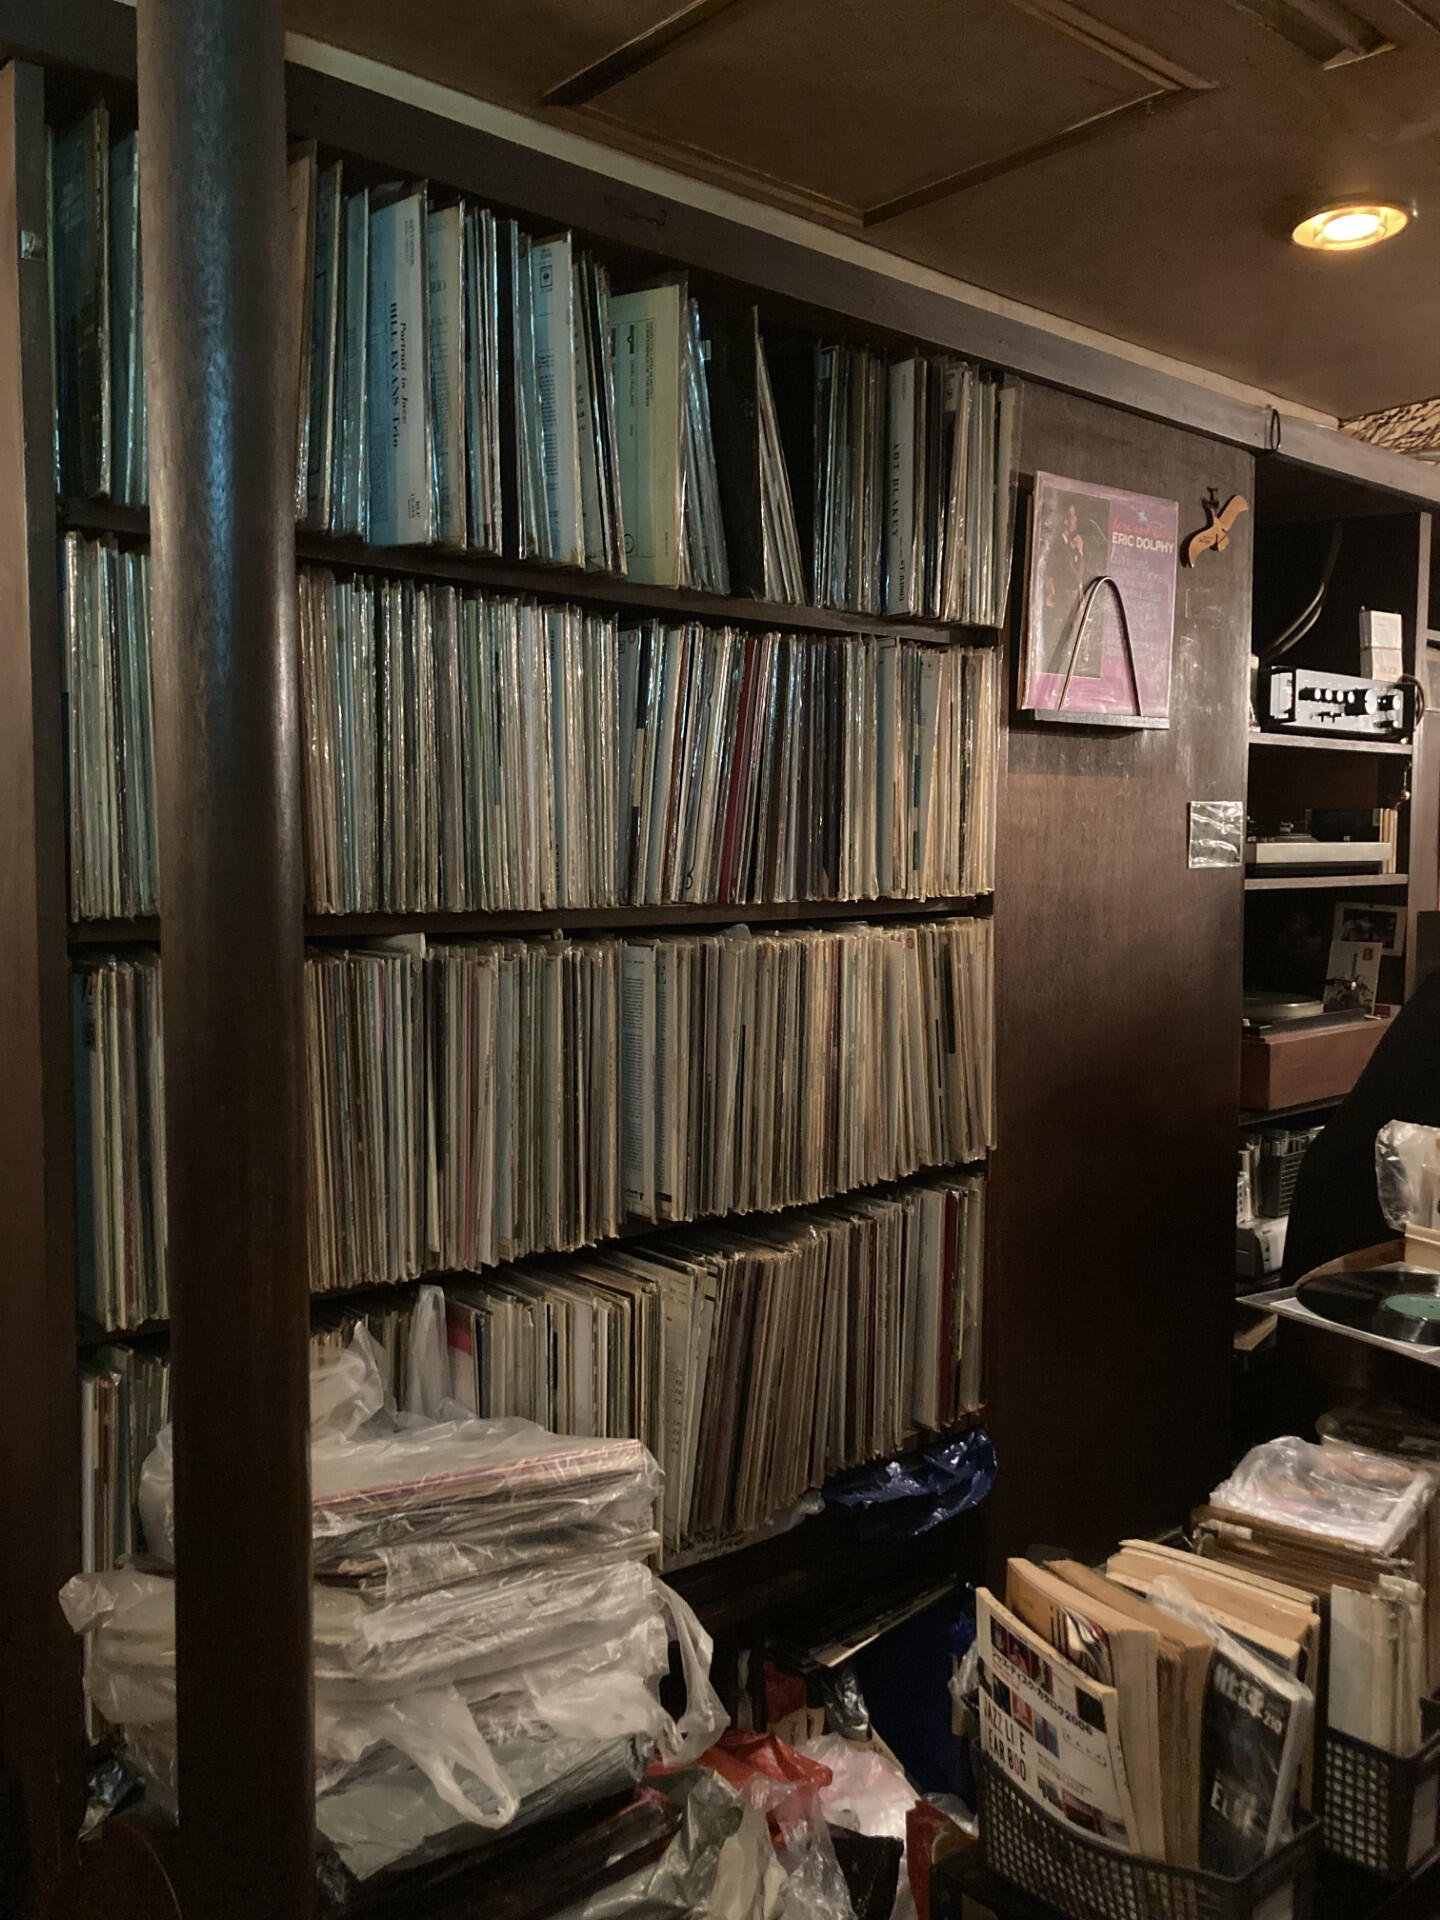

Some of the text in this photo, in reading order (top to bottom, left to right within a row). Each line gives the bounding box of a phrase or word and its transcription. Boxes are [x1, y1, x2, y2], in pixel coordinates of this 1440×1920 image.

[390, 302, 399, 340] BILL
[390, 350, 400, 407] EVANS
[891, 442, 900, 537] ART BLAKEY
[1112, 531, 1175, 554] ERIC DOLPHY
[984, 1696, 1003, 1734] JAZZ
